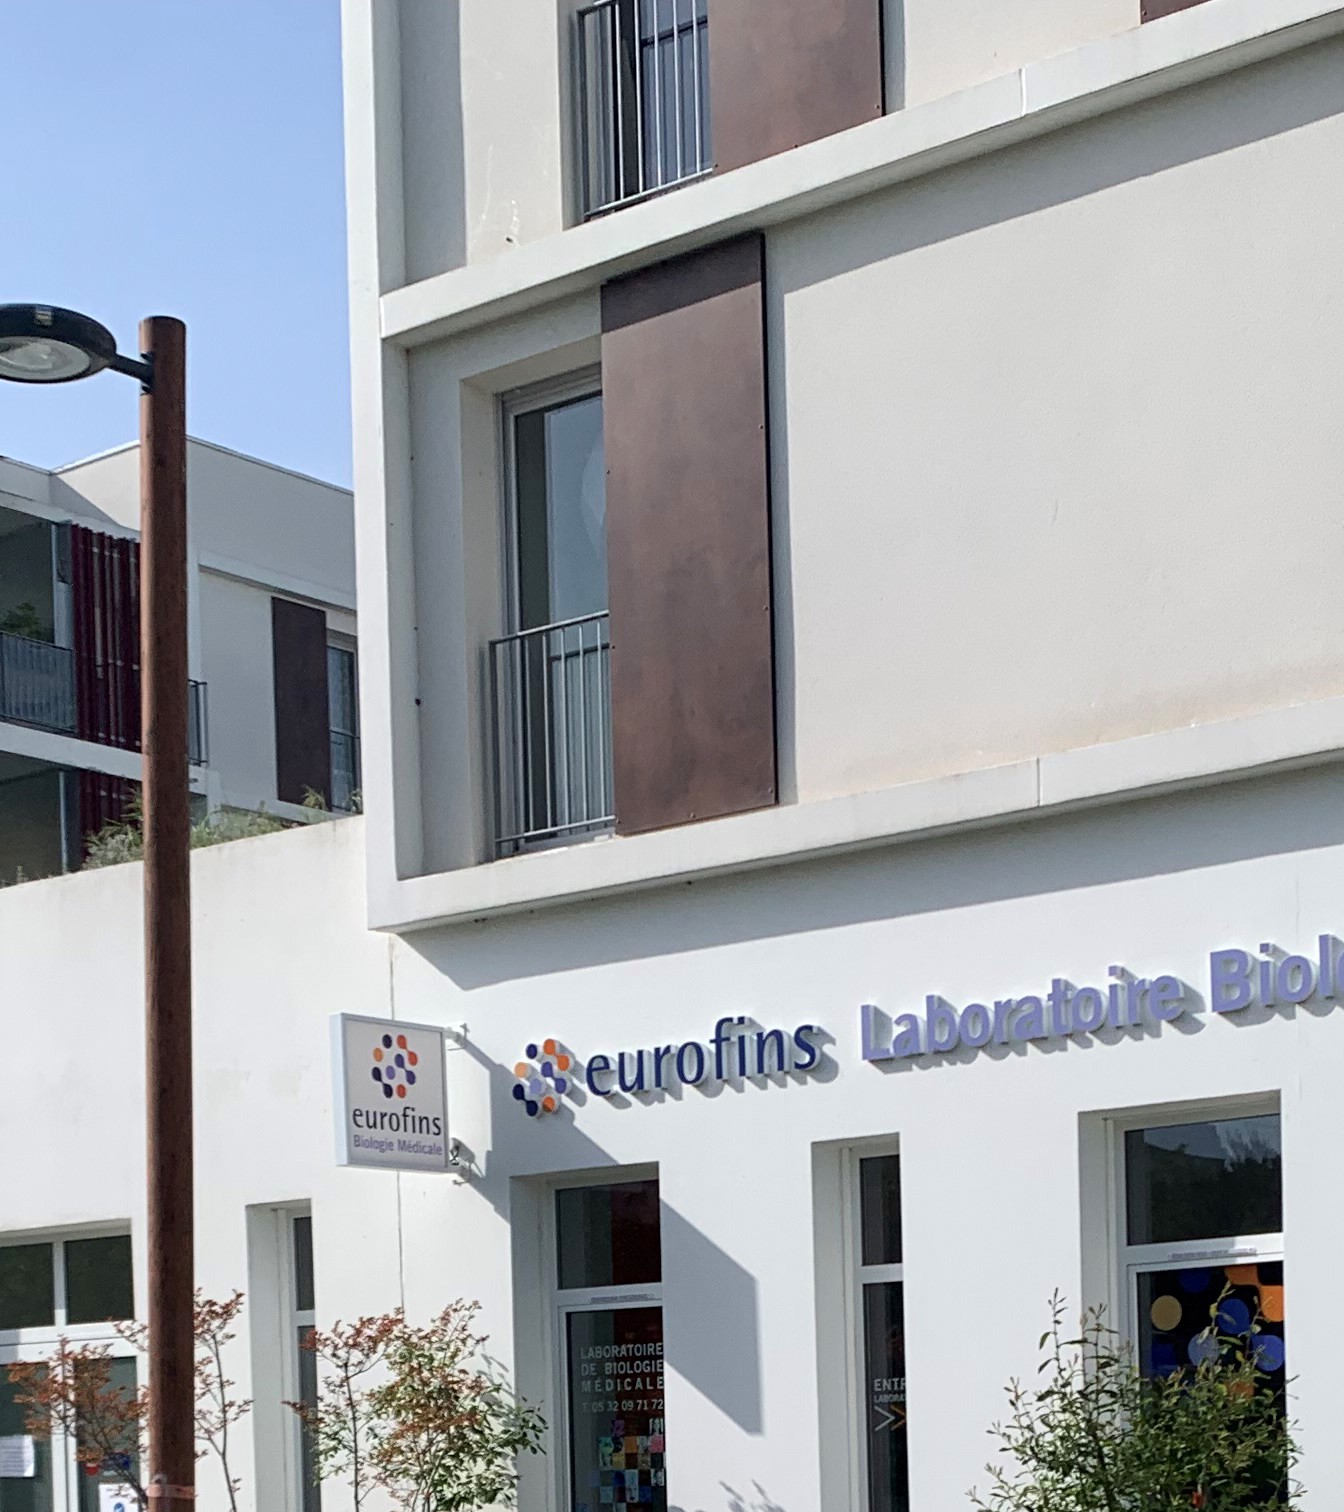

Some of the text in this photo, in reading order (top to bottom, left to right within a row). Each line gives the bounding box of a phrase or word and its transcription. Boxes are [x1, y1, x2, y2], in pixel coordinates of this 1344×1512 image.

[861, 969, 1181, 1061] Laboratoire
[586, 1016, 817, 1096] eurofins
[352, 1107, 441, 1136] eurofins
[353, 1135, 443, 1156] Biologie Médicale
[580, 1343, 663, 1359] LABORATOIRE
[581, 1359, 664, 1376] DE BIOLOGIE
[581, 1377, 664, 1392] MÉDICALE
[637, 1400, 648, 1411] 71
[652, 1399, 663, 1410] 72
